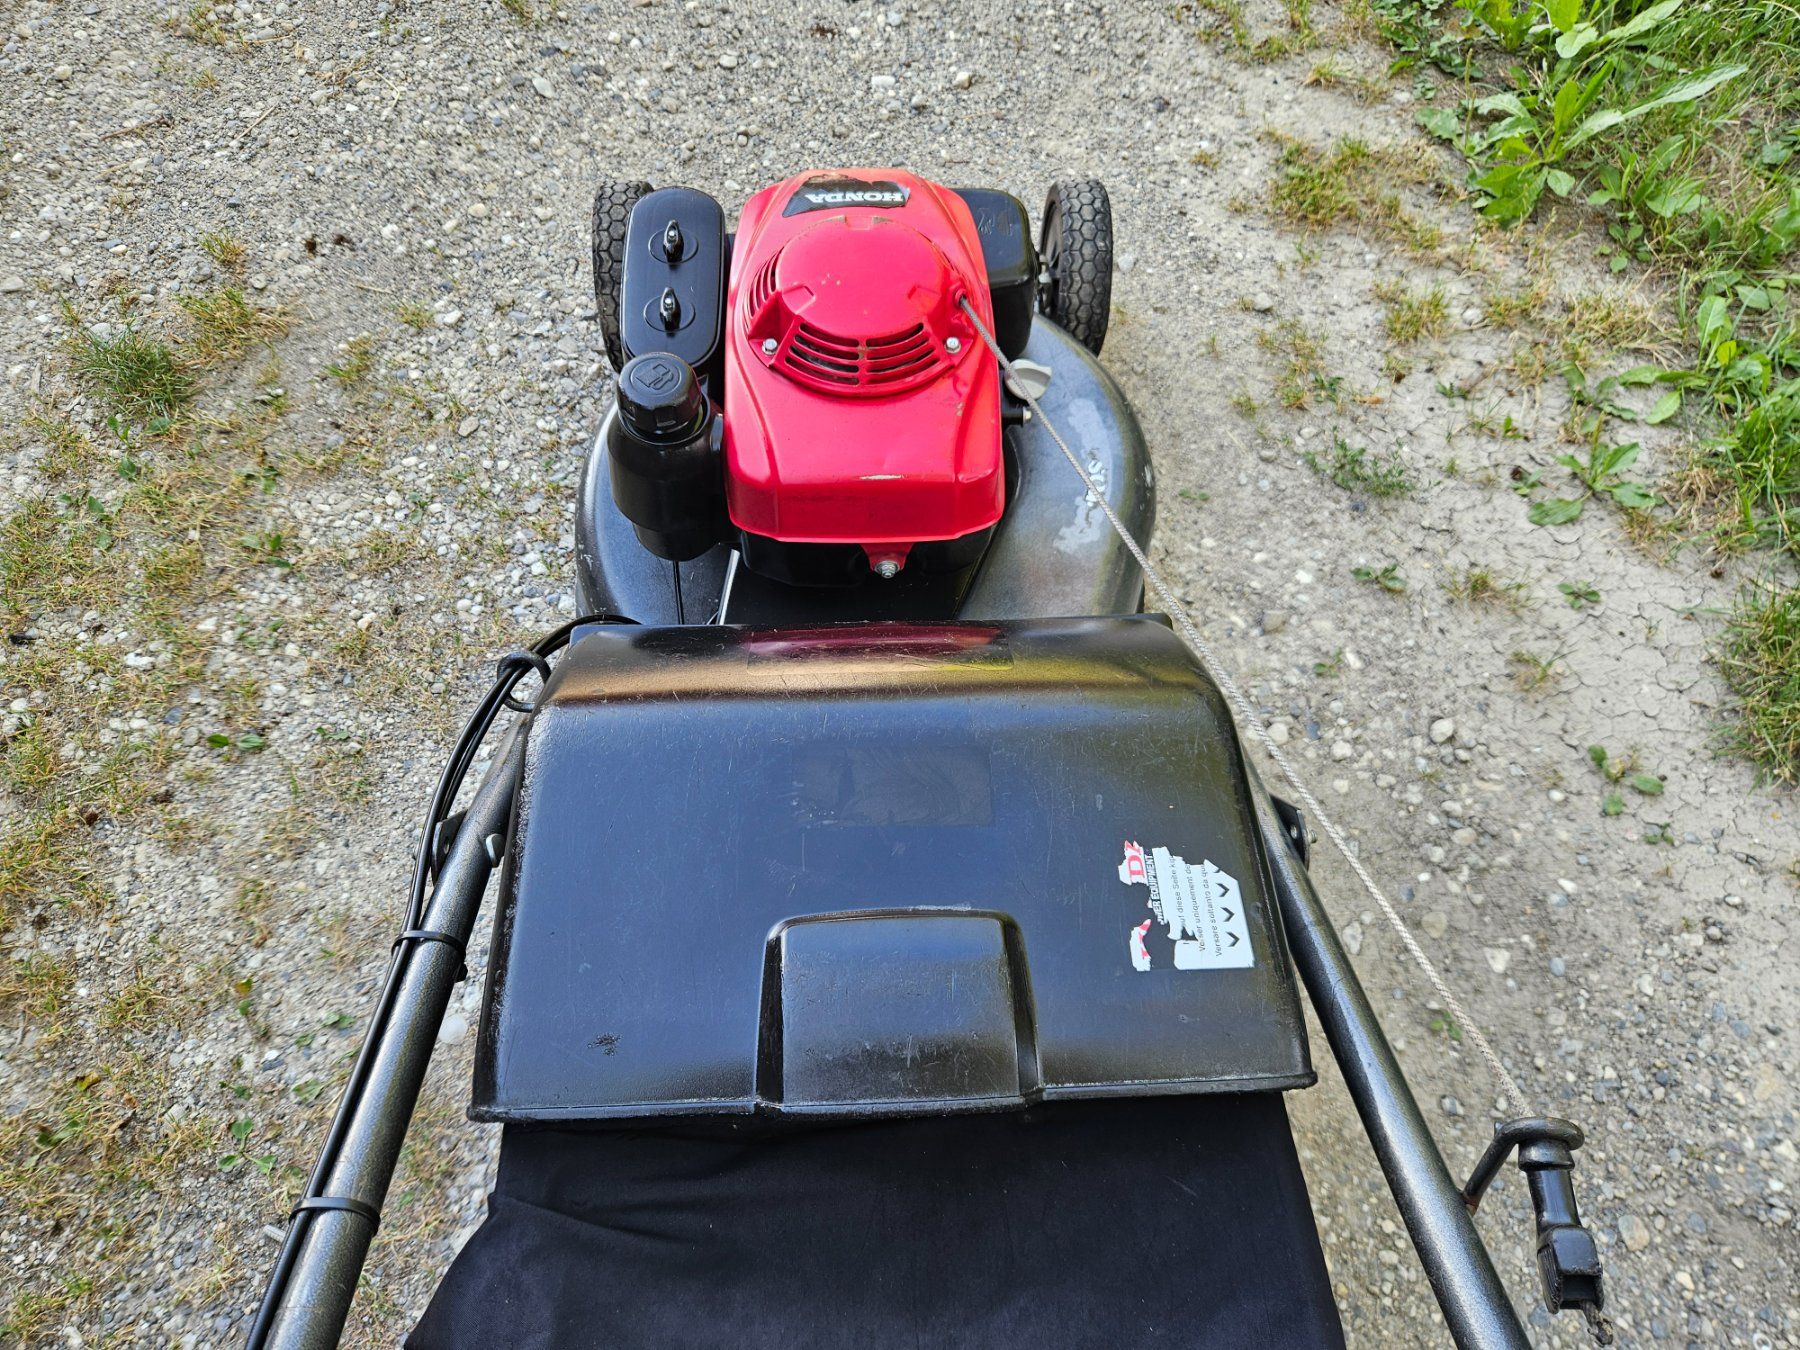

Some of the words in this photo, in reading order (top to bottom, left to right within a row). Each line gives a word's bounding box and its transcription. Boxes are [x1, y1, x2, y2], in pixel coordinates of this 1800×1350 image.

[805, 191, 904, 204] HONDA
[1145, 854, 1160, 899] EQUIPMENT
[1171, 870, 1180, 889] Seite
[1175, 892, 1183, 913] diese
[1187, 877, 1201, 923] uniquement
[1205, 891, 1216, 923] soltanto
[1212, 926, 1222, 956] Versare
